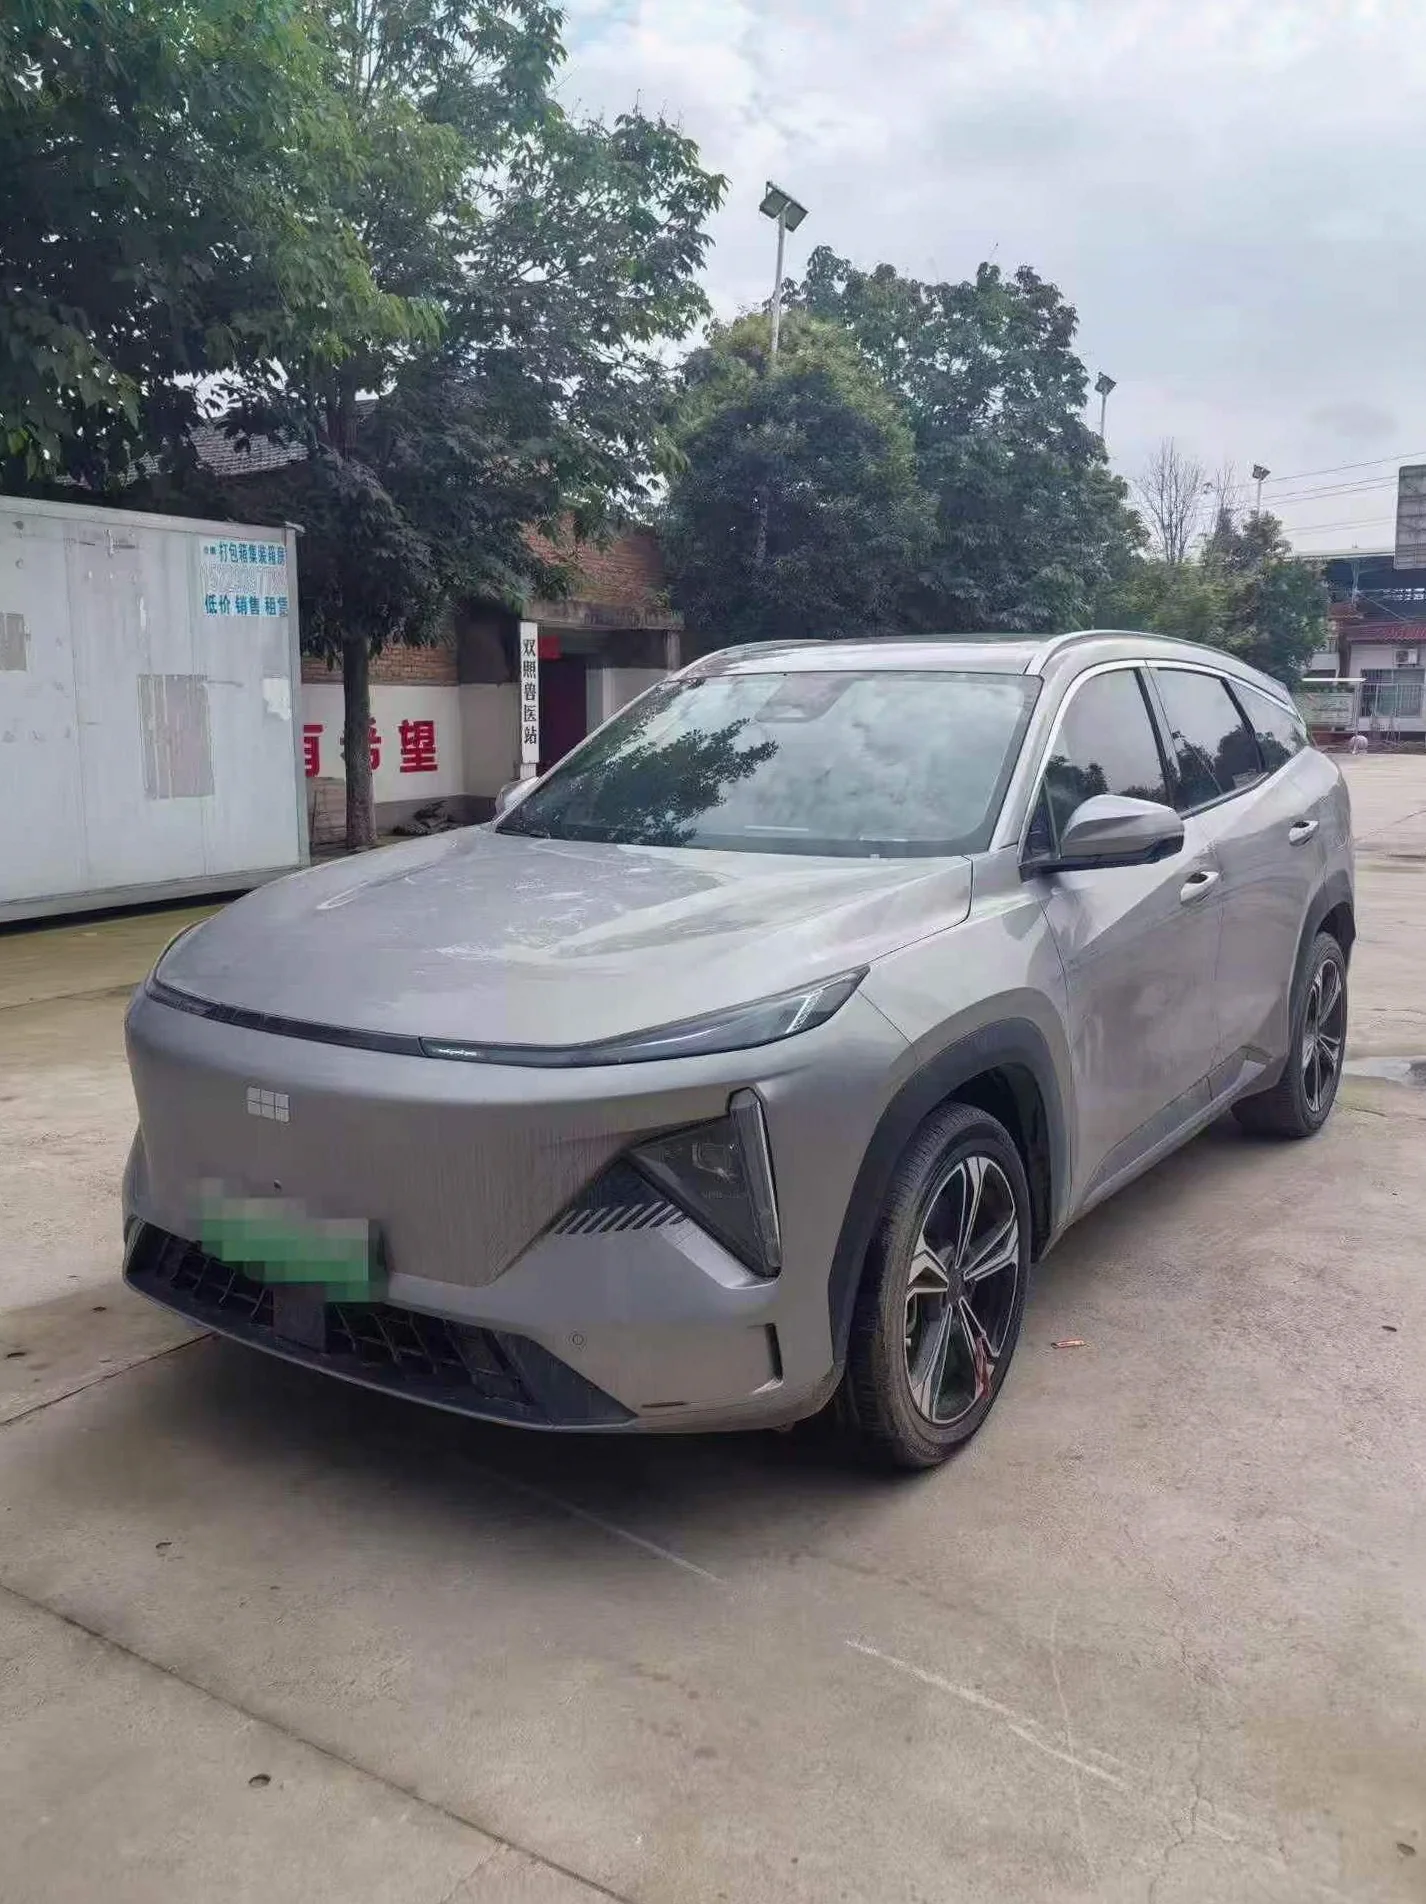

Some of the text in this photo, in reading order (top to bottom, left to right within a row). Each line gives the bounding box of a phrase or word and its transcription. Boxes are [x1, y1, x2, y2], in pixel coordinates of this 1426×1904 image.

[522, 638, 538, 745] 双照兽医站
